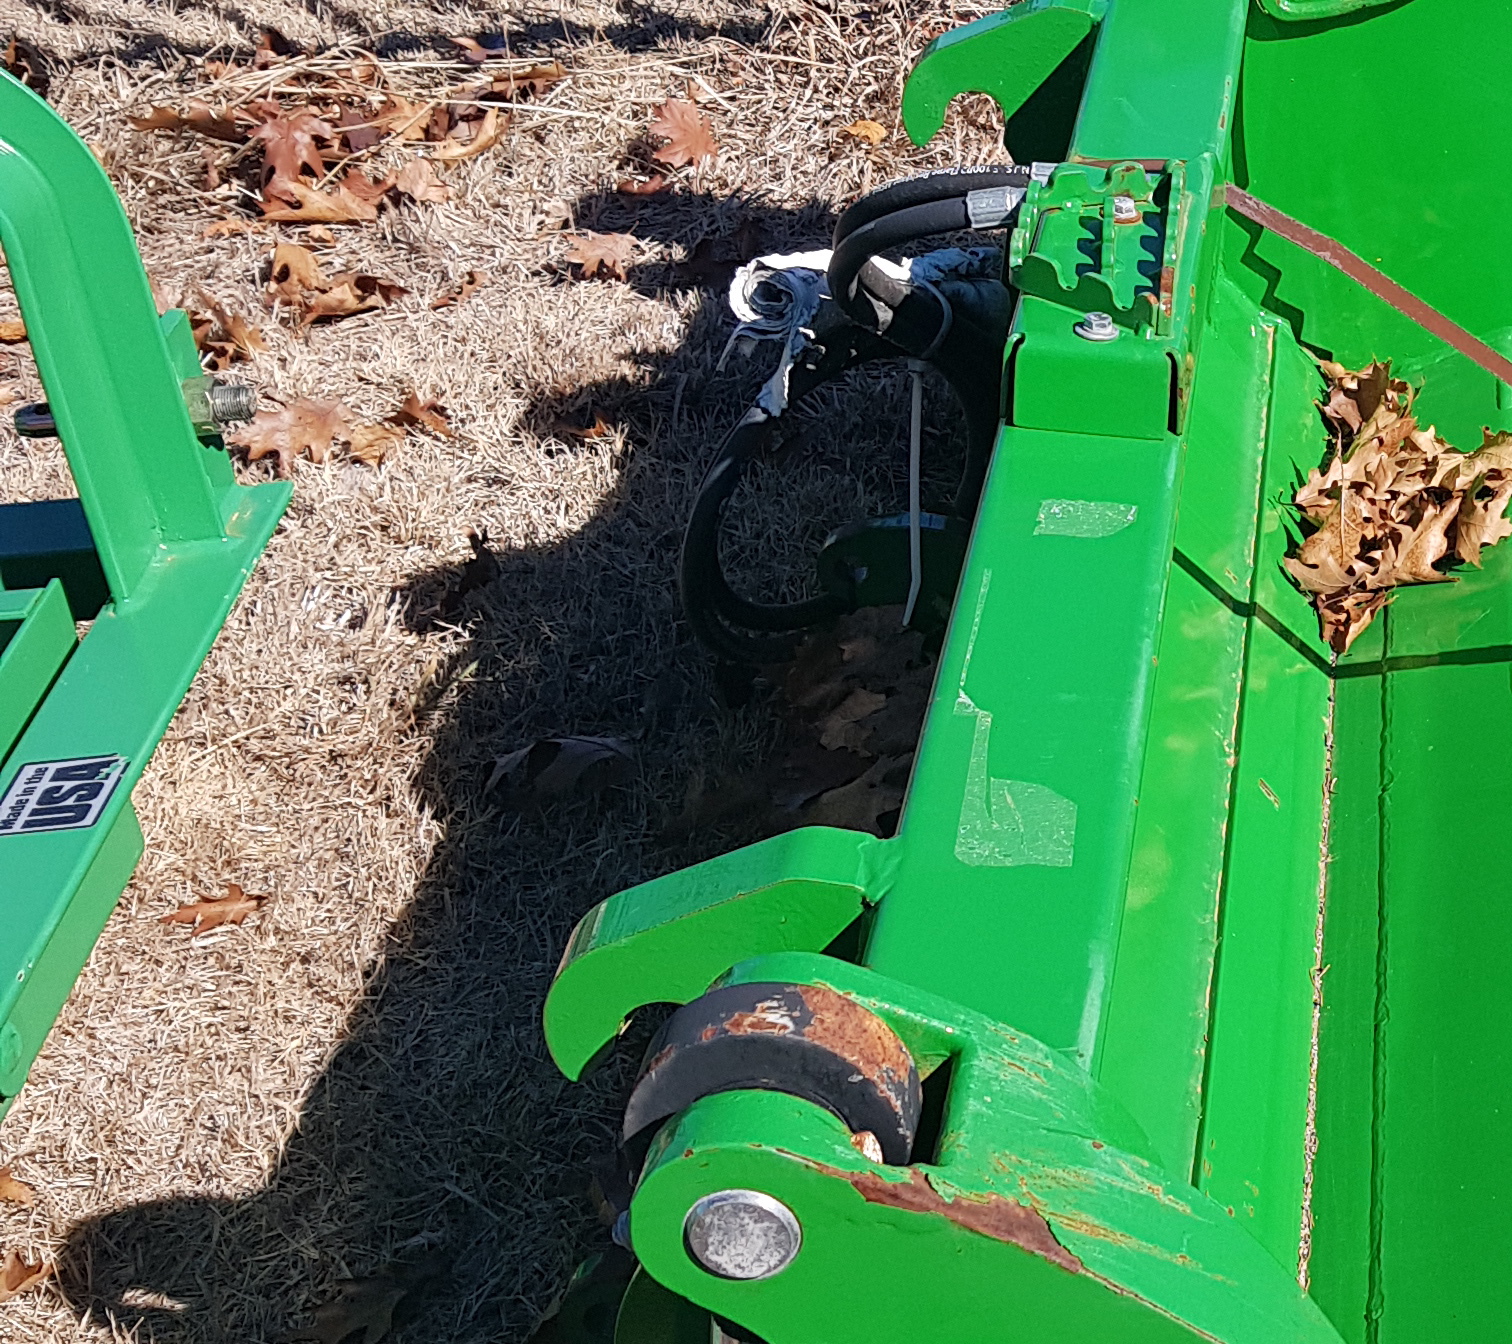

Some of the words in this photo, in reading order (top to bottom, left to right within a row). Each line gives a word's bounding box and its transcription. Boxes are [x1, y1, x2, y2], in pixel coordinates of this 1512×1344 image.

[24, 766, 50, 785] the
[15, 786, 38, 798] in
[20, 758, 120, 830] USA
[0, 798, 30, 830] Made
